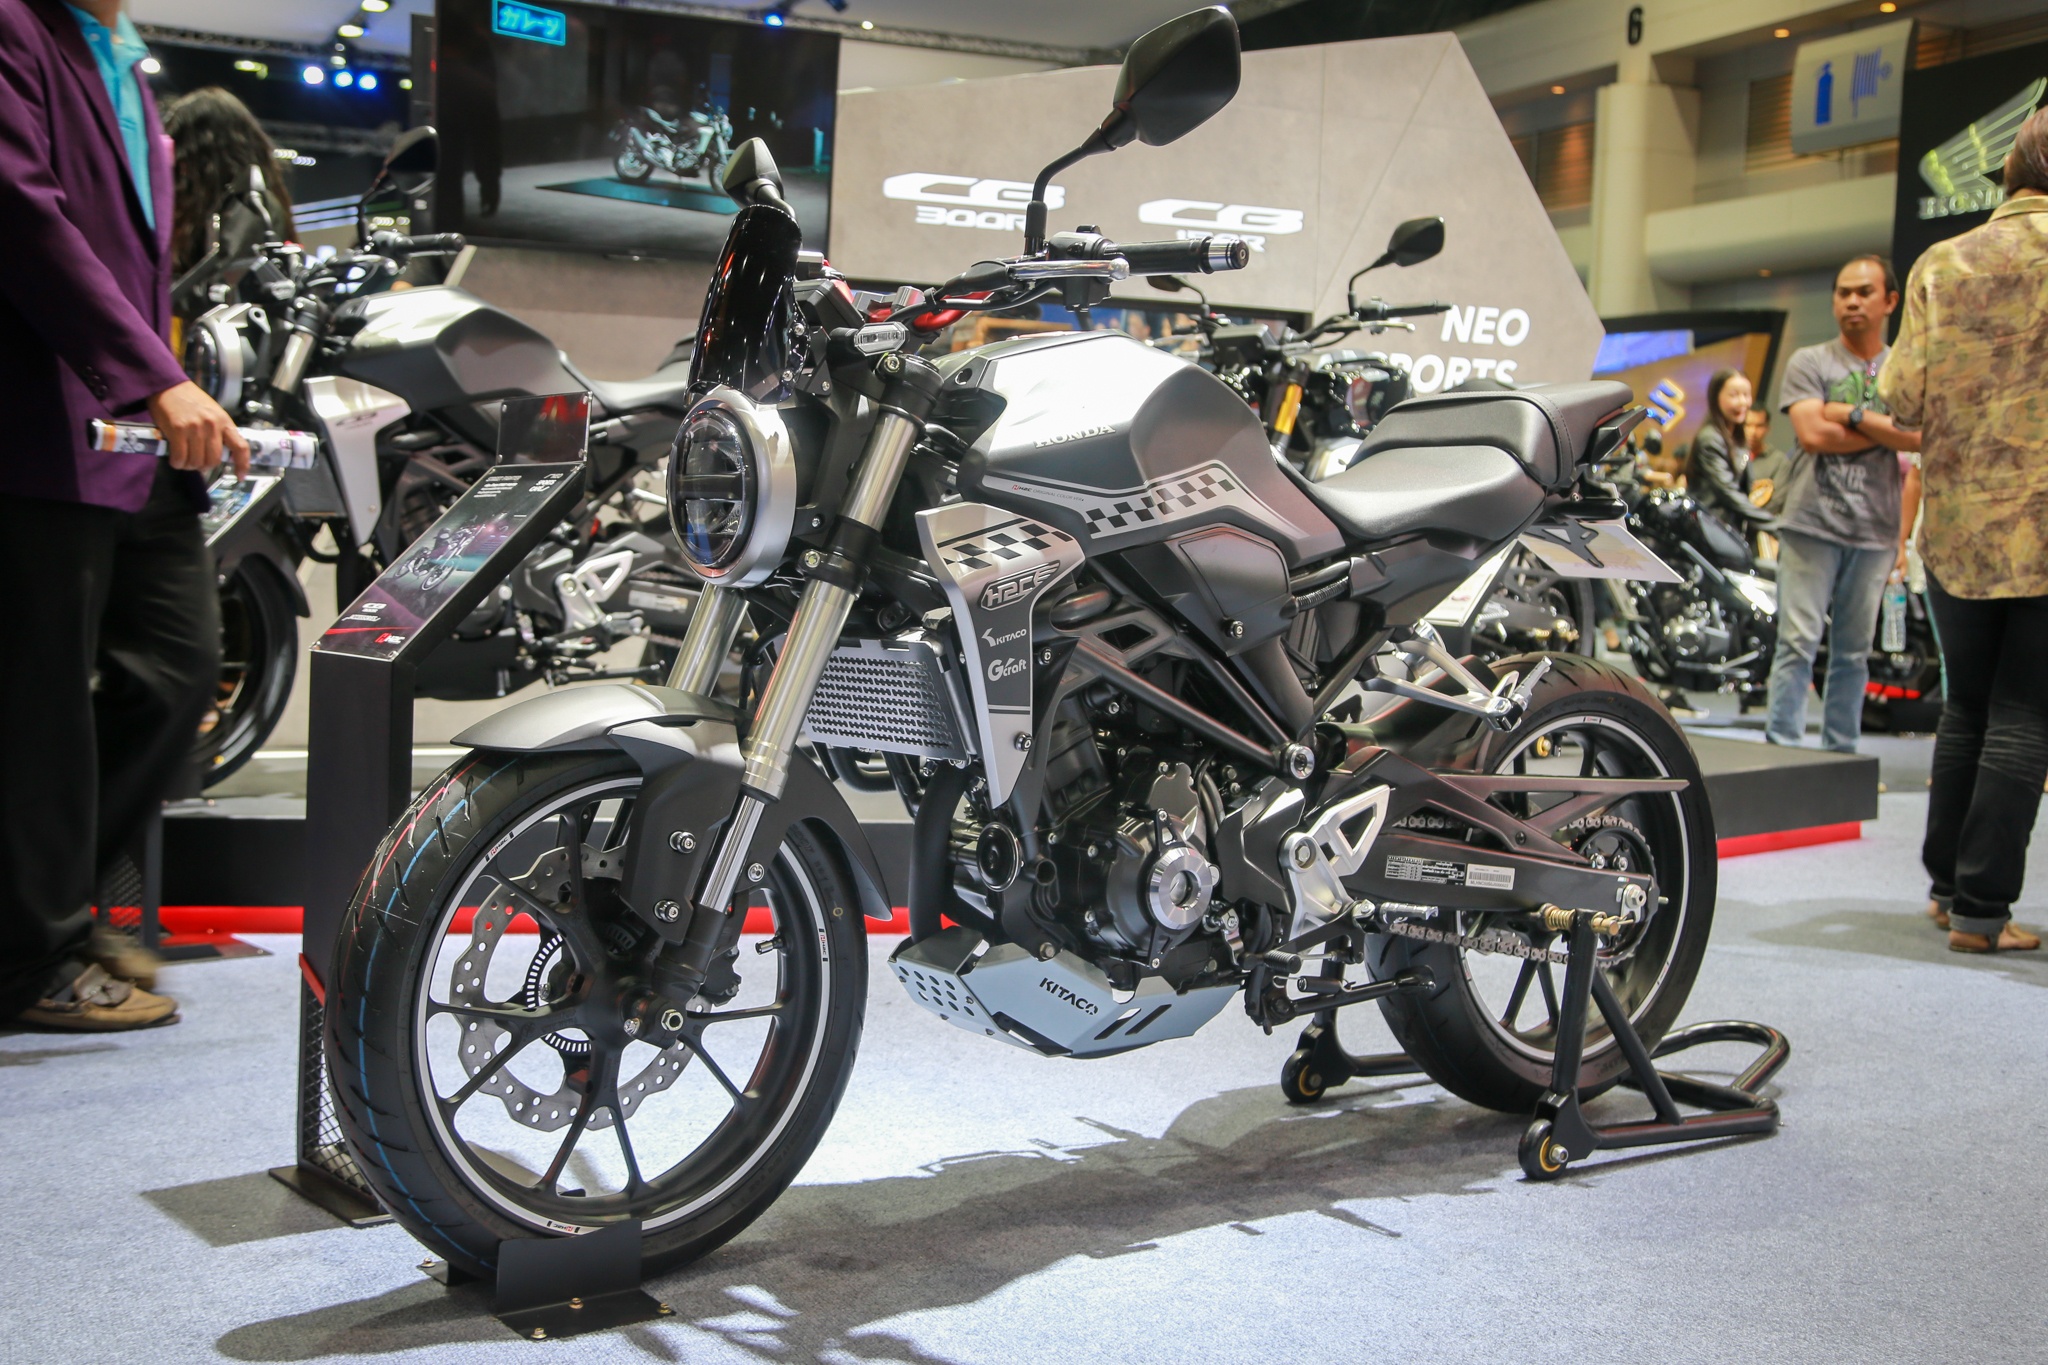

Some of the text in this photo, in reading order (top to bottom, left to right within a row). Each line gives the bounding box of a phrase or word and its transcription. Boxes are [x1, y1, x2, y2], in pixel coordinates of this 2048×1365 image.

[1628, 7, 1643, 45] 6
[882, 172, 1065, 210] CB
[1138, 198, 1304, 234] CB
[1440, 304, 1531, 347] NEO
[1034, 424, 1116, 448] HONDA
[996, 628, 1027, 646] KITACO
[1039, 977, 1098, 1015] KITACO
